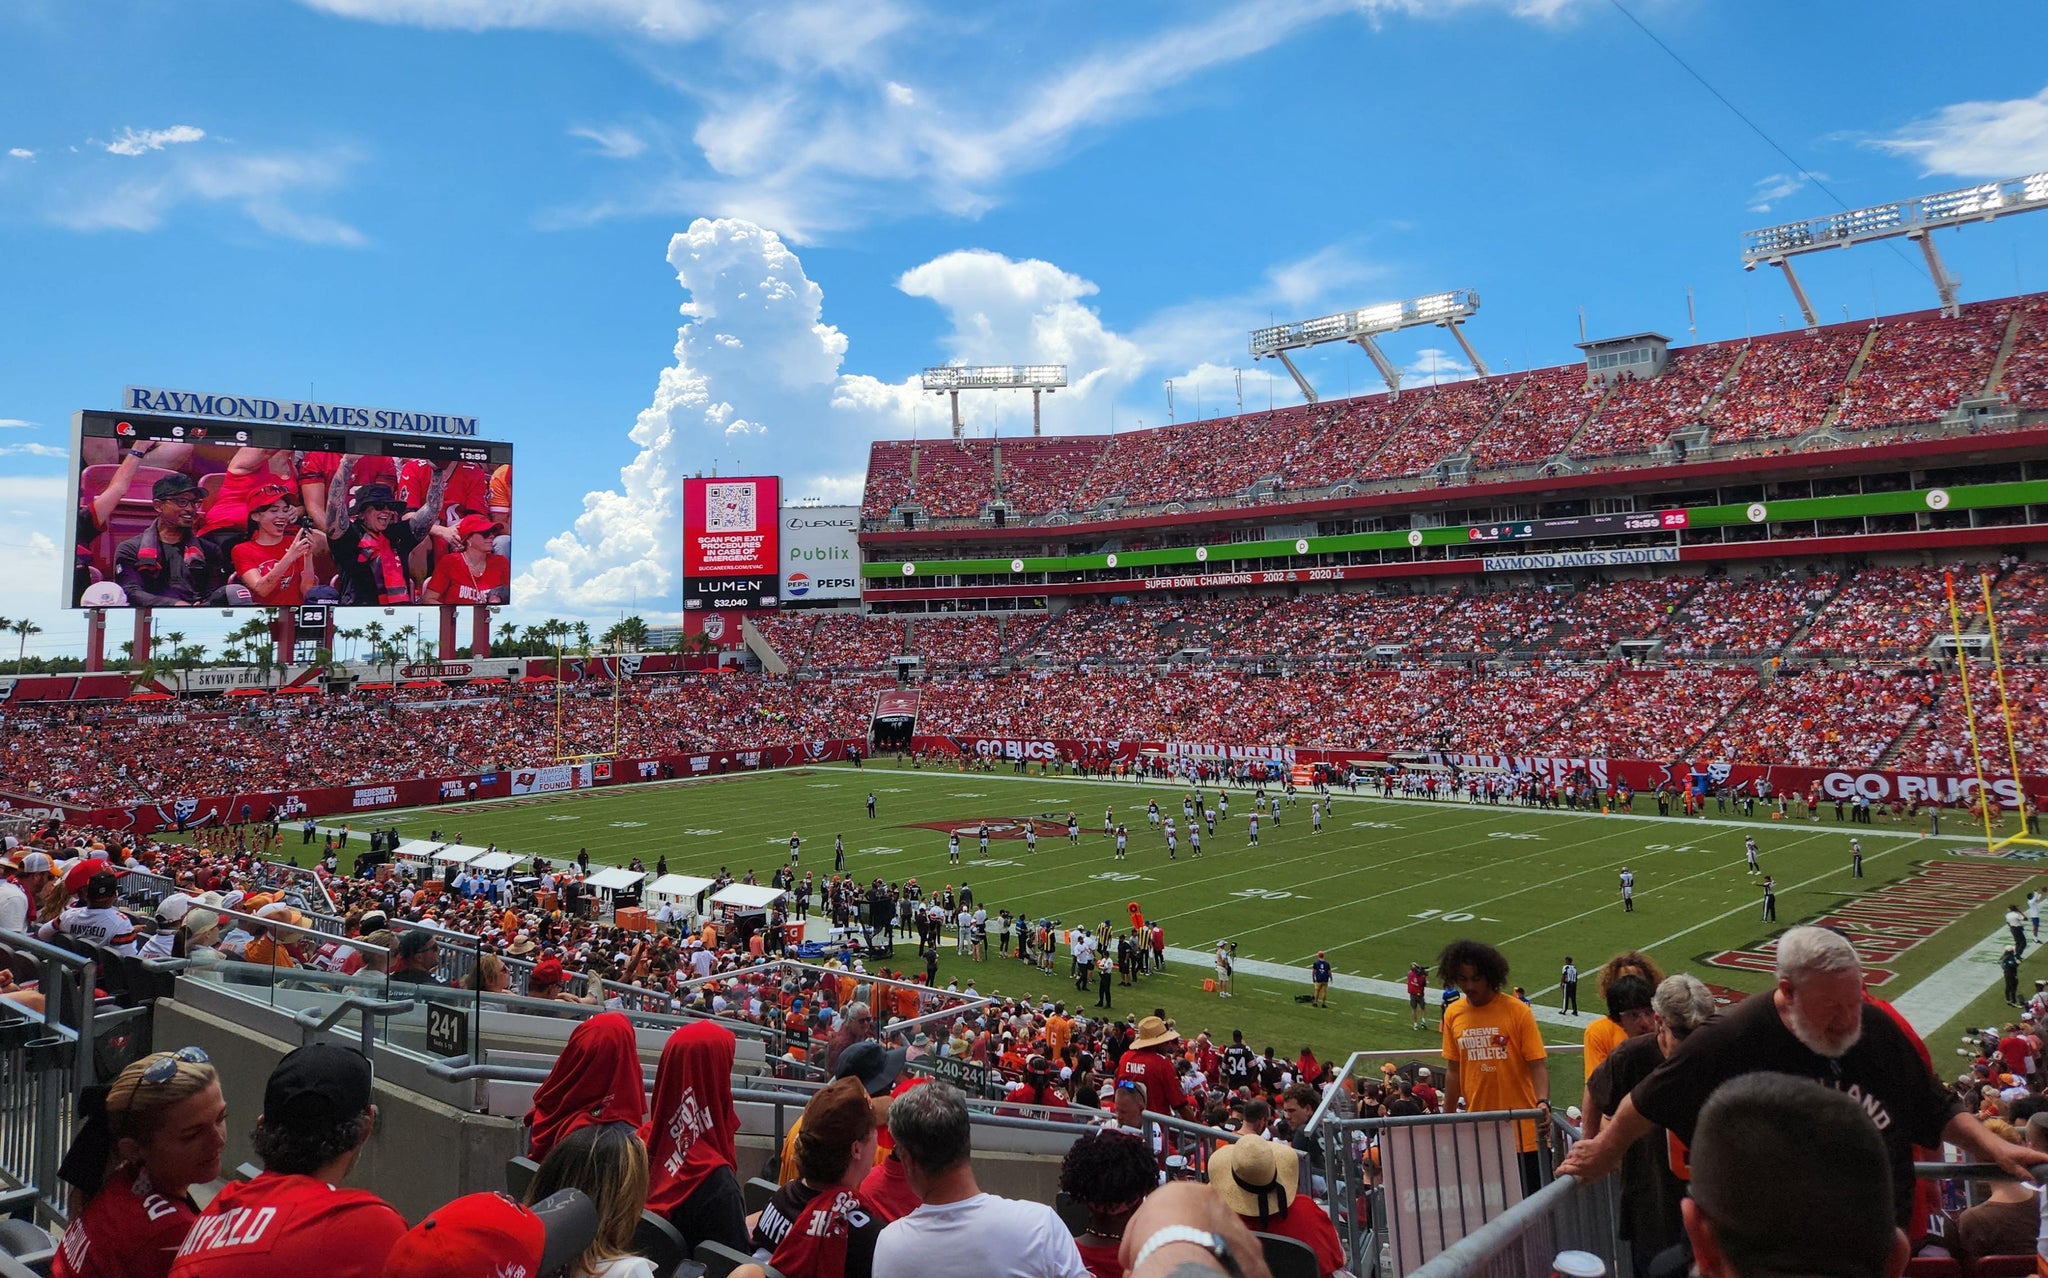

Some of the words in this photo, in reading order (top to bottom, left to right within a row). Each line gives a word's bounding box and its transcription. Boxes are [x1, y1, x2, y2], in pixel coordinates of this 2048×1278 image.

[132, 388, 280, 420] RAYMOND
[284, 402, 369, 427] JAMES
[374, 410, 477, 436] STADIUM
[172, 426, 184, 437] 6
[236, 431, 248, 442] 6
[460, 453, 487, 461] 13:59
[1624, 519, 1660, 529] 13:59
[1665, 514, 1685, 524] 25
[1493, 528, 1502, 537] 6
[1529, 525, 1538, 534] 6
[698, 536, 723, 544] SCAN
[703, 554, 759, 562] EMERGENCY
[790, 546, 849, 560] Publix
[1485, 556, 1555, 571] RAYMOND
[1557, 553, 1606, 567] JAMES
[1610, 549, 1677, 564] STADIUM
[818, 579, 855, 588] PEPSI
[1145, 579, 1172, 589] SUPER
[1174, 577, 1199, 587] BOWL
[1200, 574, 1252, 586] CHAMPIONS
[1263, 572, 1284, 582] 2002
[1310, 570, 1331, 580] 2020
[698, 581, 761, 592] LUMEN
[714, 598, 748, 608] $32,040
[303, 612, 322, 621] 25
[445, 665, 464, 675] BITES
[199, 673, 236, 686] SKYWAY
[238, 671, 263, 684] GRILL
[976, 739, 1002, 755] GO
[1006, 741, 1055, 759] BUCS
[1824, 772, 1890, 800] GO
[1897, 775, 2026, 807] BUCS
[353, 796, 374, 807] BLOCK
[375, 794, 398, 804] PARTY
[1229, 888, 1292, 900] 20
[1408, 909, 1475, 922] 10
[70, 924, 106, 938] MAYFIELD
[430, 1010, 458, 1043] 241
[1463, 1027, 1499, 1037] KREWE
[1050, 1033, 1057, 1044] 6
[1468, 1046, 1508, 1061] ATHLETES
[936, 1059, 984, 1085] 240-241
[1126, 1061, 1146, 1075] EVANS
[1227, 1057, 1247, 1076] 34
[143, 1193, 177, 1222] 2
